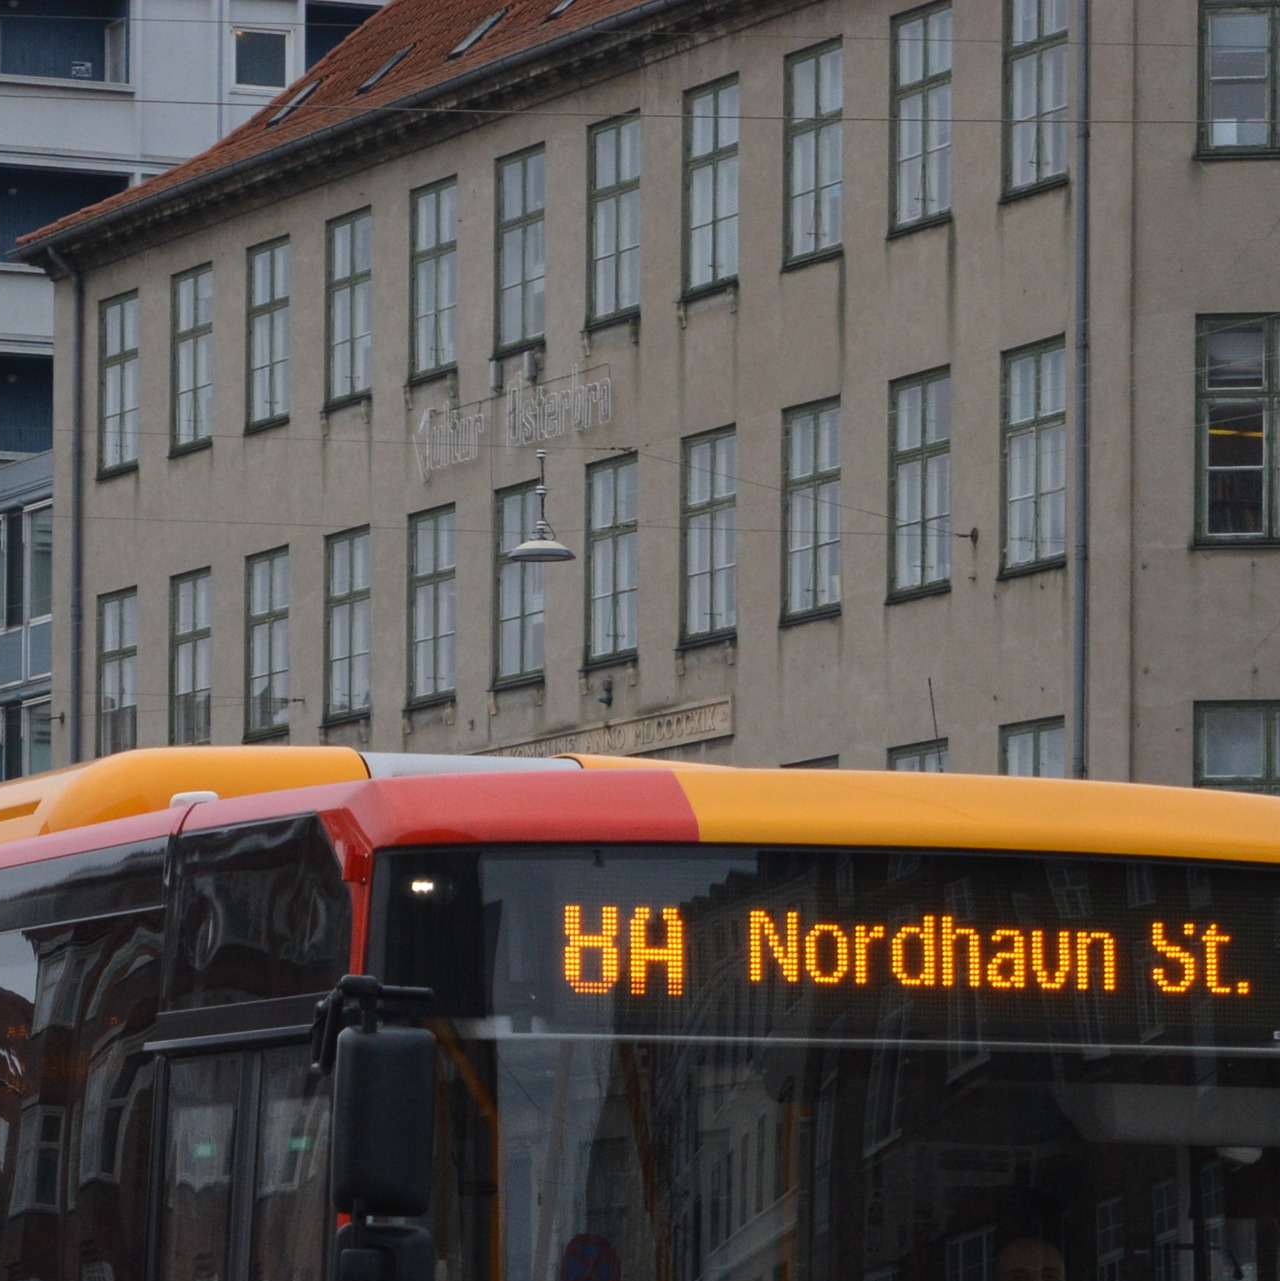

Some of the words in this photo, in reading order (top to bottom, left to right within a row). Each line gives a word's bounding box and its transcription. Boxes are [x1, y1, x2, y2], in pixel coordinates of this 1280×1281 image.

[507, 363, 611, 449] Østerbro
[586, 729, 625, 751] ANNO
[749, 909, 1116, 991] Nordhavn
[1152, 921, 1251, 995] St.
